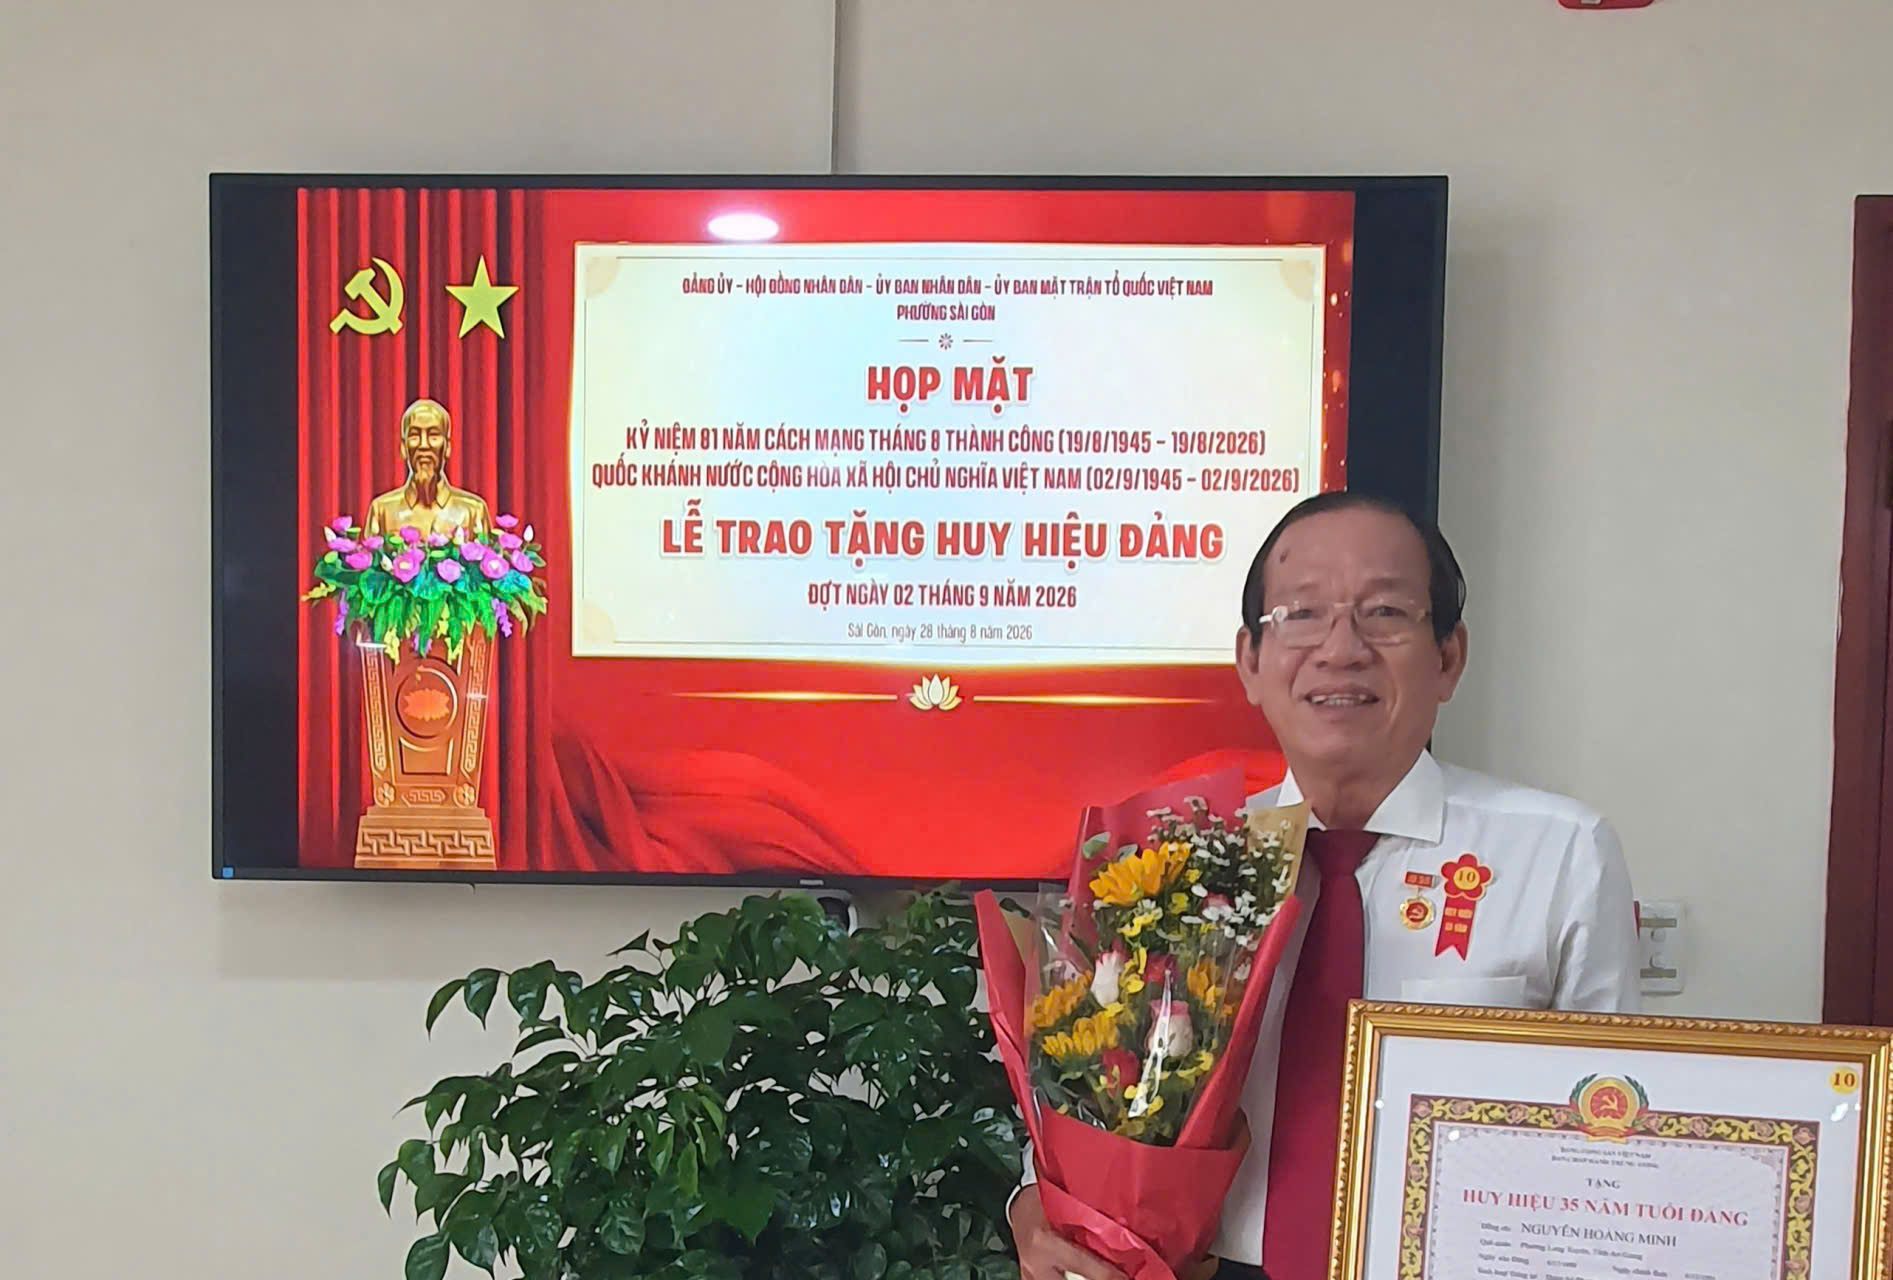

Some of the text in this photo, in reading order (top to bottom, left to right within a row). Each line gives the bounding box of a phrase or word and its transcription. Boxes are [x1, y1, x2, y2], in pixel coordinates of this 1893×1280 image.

[717, 272, 732, 294] ỦY
[746, 274, 766, 297] HỘI
[803, 275, 836, 294] NHÂN
[840, 275, 862, 294] DÂN
[876, 273, 891, 294] ỦY
[894, 279, 918, 294] BAN
[922, 275, 954, 294] NHÂN
[958, 275, 981, 294] DÂN
[994, 273, 1010, 295] ỦY
[1014, 280, 1038, 295] BAN
[1040, 276, 1066, 300] MẶT
[1070, 276, 1102, 300] TRẬN
[1105, 270, 1120, 296] TỔ
[1122, 272, 1154, 297] QUỐC
[1158, 276, 1184, 300] VIỆT
[1186, 280, 1213, 296] NAM
[897, 301, 996, 320] PHƯỜNG SÀI GÒN
[867, 355, 1034, 414] HỌP MẶT
[626, 418, 650, 450] KỶ
[654, 422, 696, 456] NIỆM
[700, 427, 718, 450] 81
[722, 421, 760, 450] NĂM
[764, 422, 810, 451] CÁCH
[815, 428, 864, 457] MẠNG
[869, 423, 927, 452] THÁNG
[931, 429, 940, 452] 8
[946, 424, 1004, 452] THÀNH
[1008, 425, 1054, 453] CÔNG
[592, 452, 637, 488] QUỐC
[642, 459, 701, 487] KHÁNH
[706, 459, 753, 487] NƯỚC
[757, 460, 803, 494] CỘNG
[807, 460, 842, 488] HÒA
[846, 460, 868, 488] XÃ
[872, 460, 901, 494] HỘI
[906, 458, 941, 488] CHỦ
[945, 461, 998, 489] NGHĨA
[1002, 462, 1041, 495] VIỆT
[1044, 467, 1082, 490] NAM
[662, 498, 1224, 569] LỄ TRAO TẶNG HUY HIỆU ĐẢNG
[808, 578, 1077, 612] ĐỢT NGÀY 02 THÁNG 9 NĂM 2026
[891, 625, 916, 642] ngày
[920, 624, 933, 638] 28
[937, 623, 966, 644] tháng
[970, 625, 977, 639] 8
[1006, 624, 1032, 640] 2026
[1834, 1072, 1856, 1087] 10
[1464, 1188, 1502, 1206] HUY
[1508, 1192, 1555, 1212] HIỆU
[1560, 1197, 1579, 1212] 35
[1638, 1233, 1677, 1247] MINH
